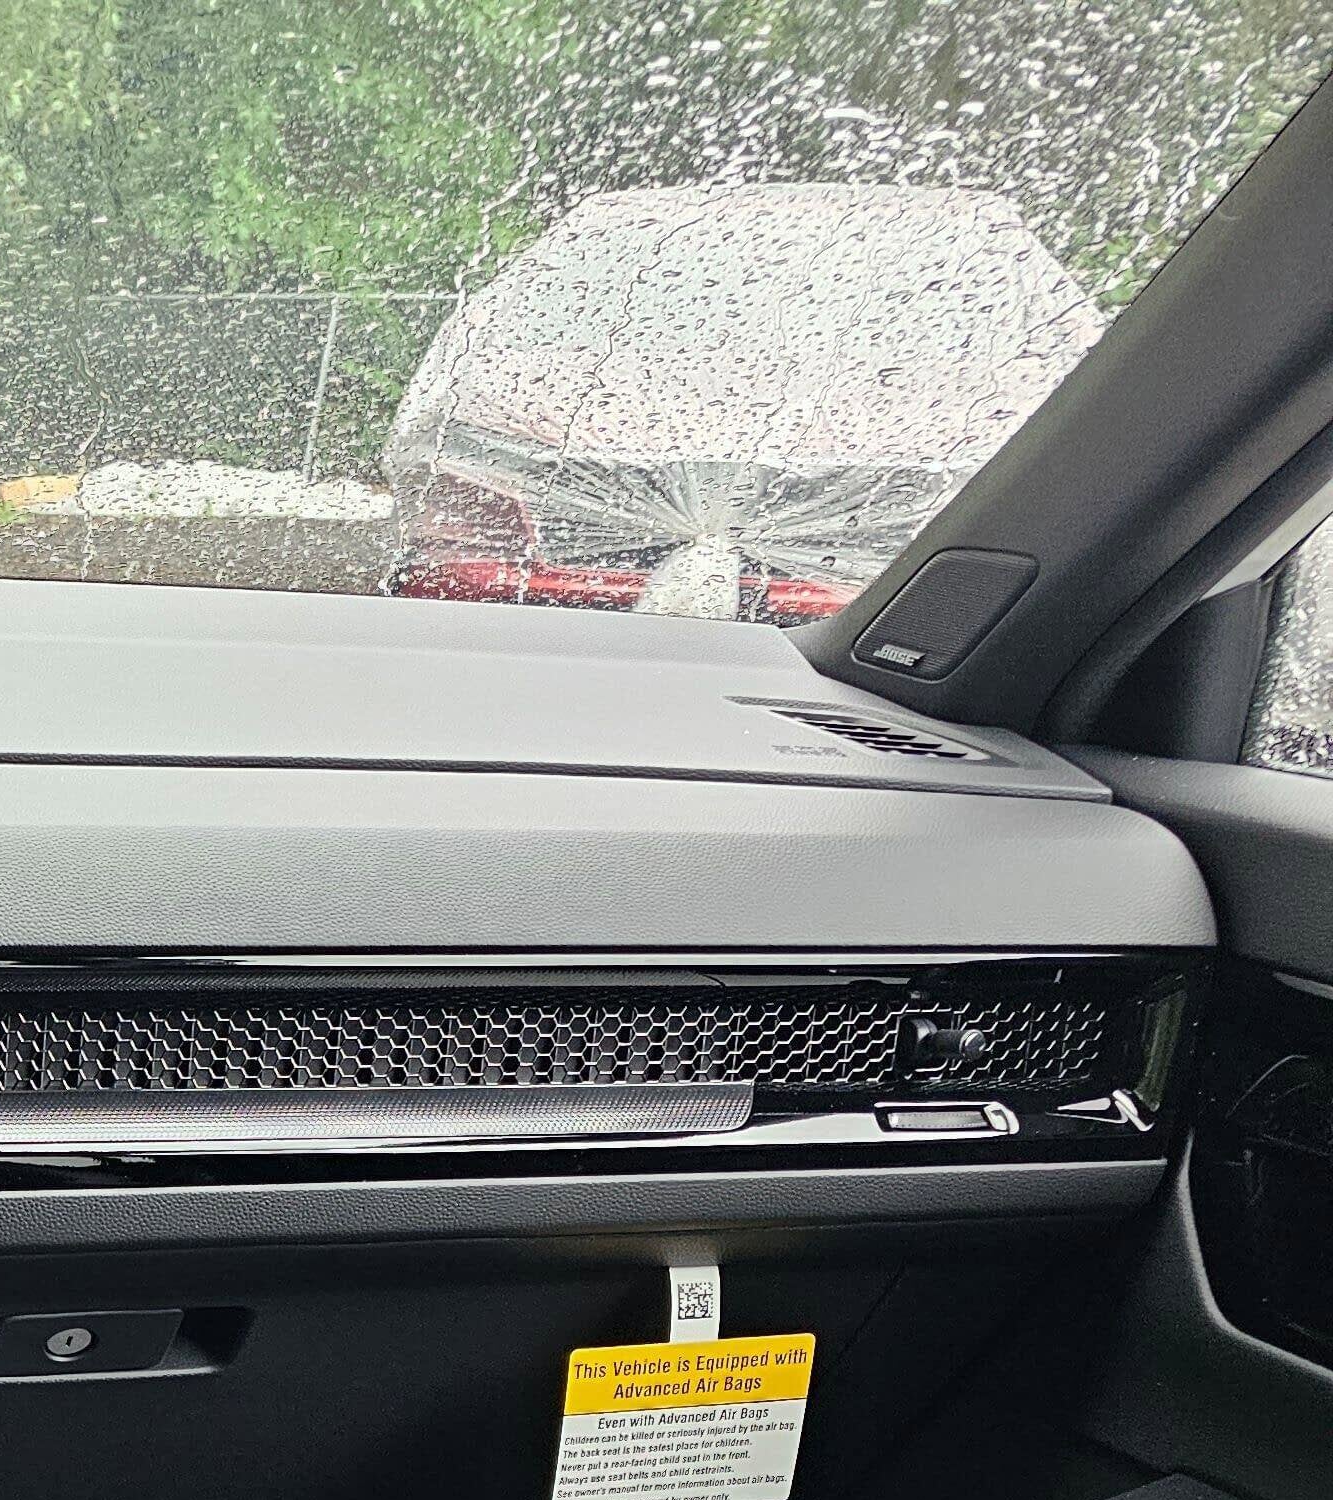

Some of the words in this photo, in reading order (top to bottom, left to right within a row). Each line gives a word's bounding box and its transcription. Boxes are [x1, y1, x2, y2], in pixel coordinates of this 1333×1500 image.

[575, 1363, 607, 1380] This
[613, 1359, 671, 1377] Vehicle
[677, 1356, 690, 1373] is
[696, 1350, 770, 1374] Equipped
[774, 1348, 807, 1365] with
[613, 1378, 691, 1400] Advanced
[695, 1377, 719, 1393] Air
[724, 1376, 762, 1393] Bags
[597, 1417, 626, 1429] Even
[630, 1414, 654, 1428] with
[658, 1409, 716, 1426] Advanced
[719, 1409, 738, 1421] Air
[740, 1407, 769, 1421] Bags
[564, 1435, 600, 1446] Children
[601, 1435, 617, 1443] can
[619, 1433, 629, 1442] be
[631, 1431, 655, 1441] killed
[667, 1427, 705, 1438] seriously
[706, 1425, 737, 1437] injured
[738, 1423, 748, 1434] by
[750, 1422, 764, 1432] the
[765, 1422, 778, 1431] air
[779, 1421, 797, 1431] bag.
[563, 1450, 578, 1459] The
[580, 1448, 600, 1458] back
[602, 1447, 621, 1456] seat
[622, 1446, 631, 1454] is
[633, 1445, 646, 1453] the
[648, 1443, 674, 1453] safest
[675, 1441, 699, 1452] place
[701, 1440, 713, 1449] for
[715, 1438, 753, 1448] children.
[561, 1463, 589, 1472] Never
[587, 1461, 601, 1472] put
[610, 1458, 657, 1469] rear-facing
[659, 1455, 681, 1465] child
[682, 1454, 701, 1463] seat
[702, 1453, 711, 1461] in
[713, 1451, 727, 1460] the
[728, 1451, 751, 1460] front.
[556, 1490, 573, 1499] See
[574, 1487, 606, 1497] owner's
[608, 1483, 640, 1495] manual
[641, 1483, 653, 1492] for
[654, 1481, 676, 1490] more
[677, 1478, 725, 1489] information
[726, 1476, 751, 1486] about
[751, 1475, 764, 1484] air
[765, 1474, 787, 1484] bags.
[558, 1475, 589, 1486] Always
[608, 1473, 626, 1481] seat
[628, 1470, 649, 1480] belts
[651, 1468, 667, 1478] and
[669, 1467, 691, 1477] child
[692, 1465, 735, 1475] restraints.
